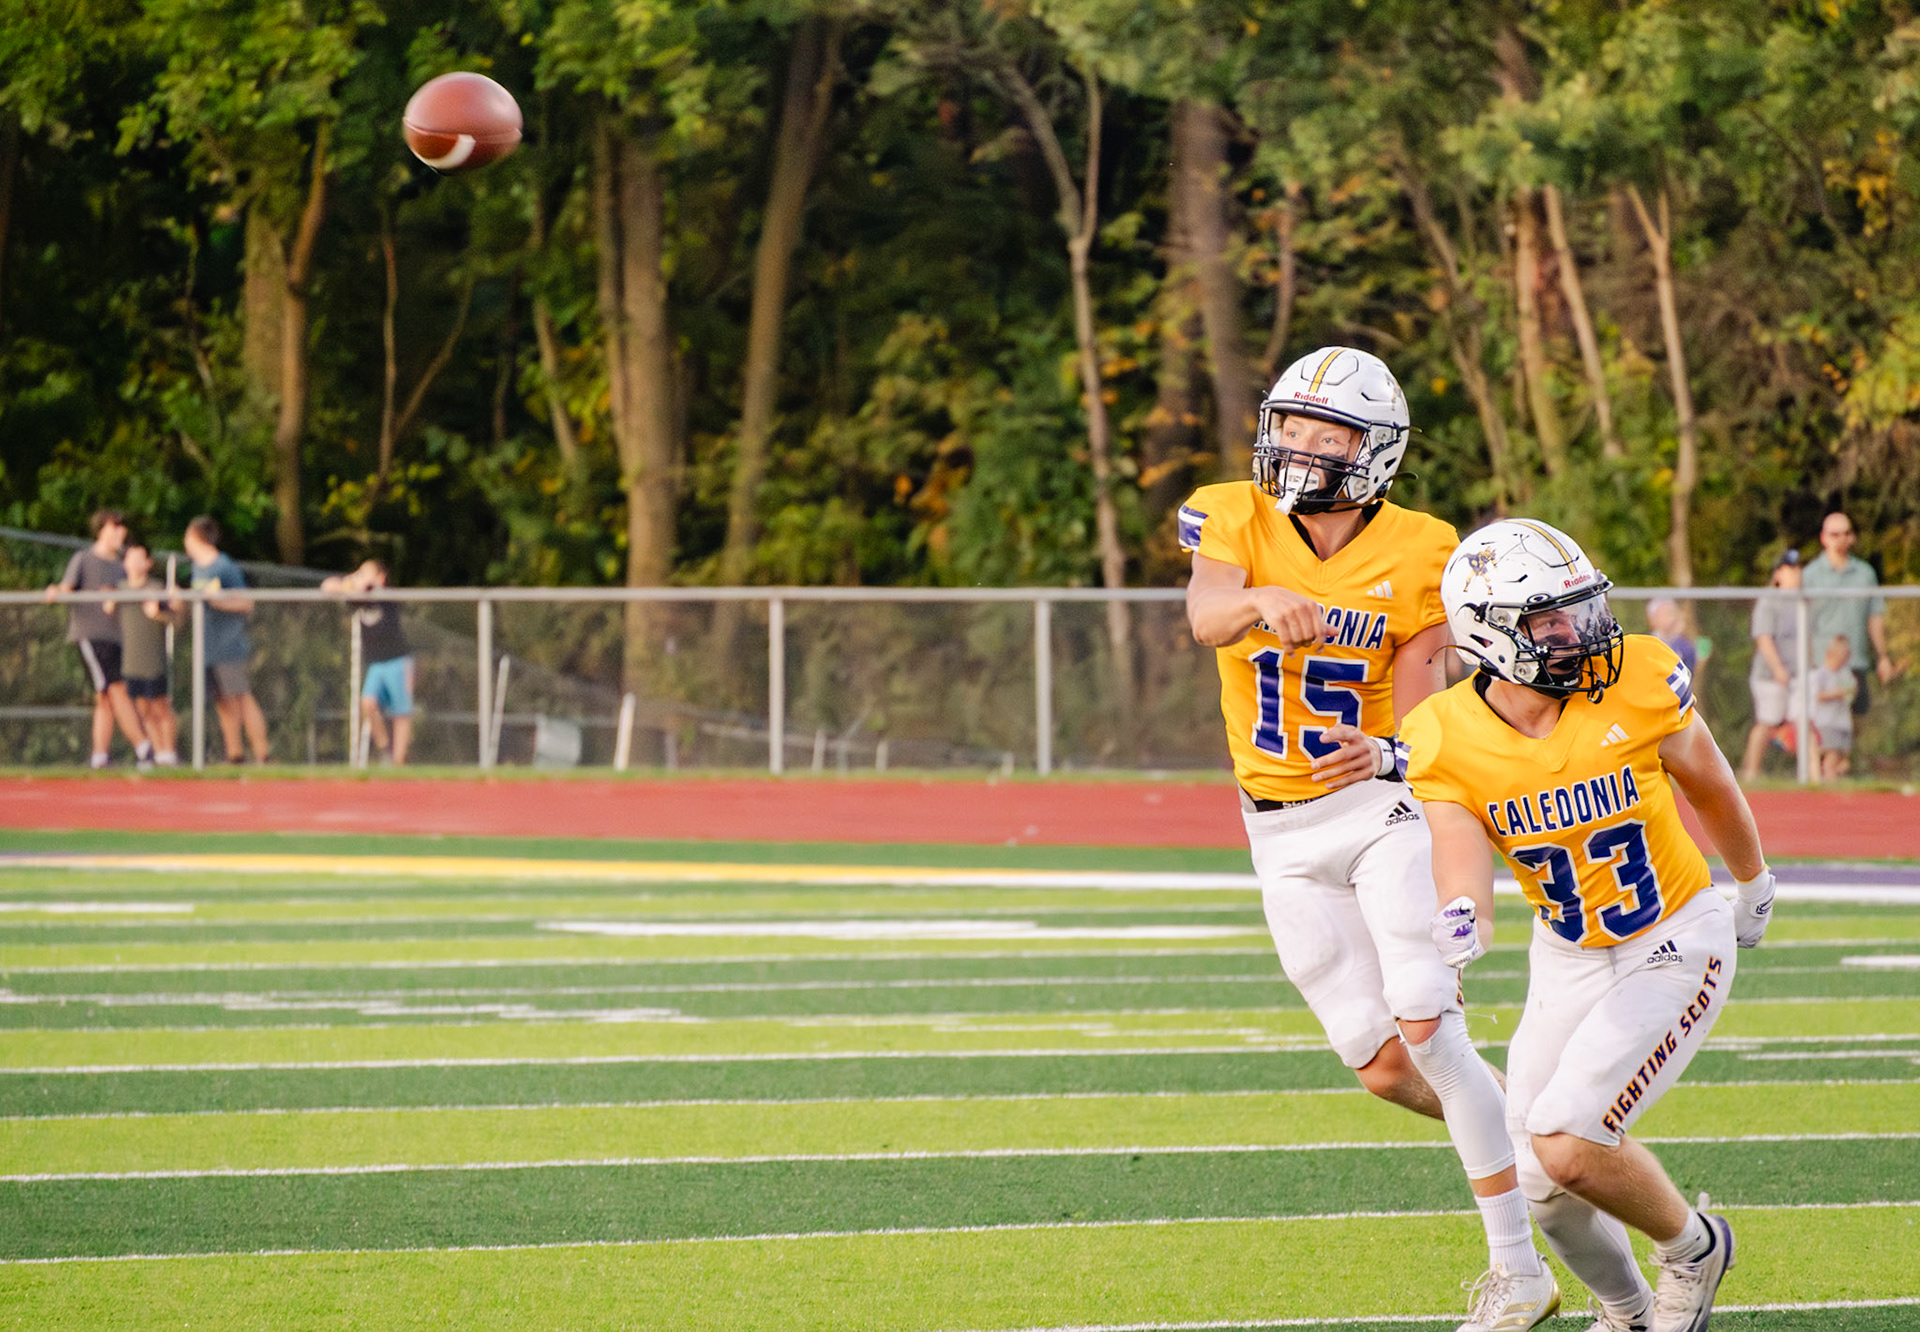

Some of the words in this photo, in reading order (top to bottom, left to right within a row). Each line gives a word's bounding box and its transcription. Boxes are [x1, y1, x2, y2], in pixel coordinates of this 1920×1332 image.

[1294, 391, 1329, 405] Riddell
[1248, 645, 1370, 761] 15
[1486, 764, 1642, 837] CALEDONIA
[1507, 817, 1666, 943] 33
[1601, 1029, 1679, 1134] FIGHTING
[1679, 955, 1722, 1039] SCOTS
